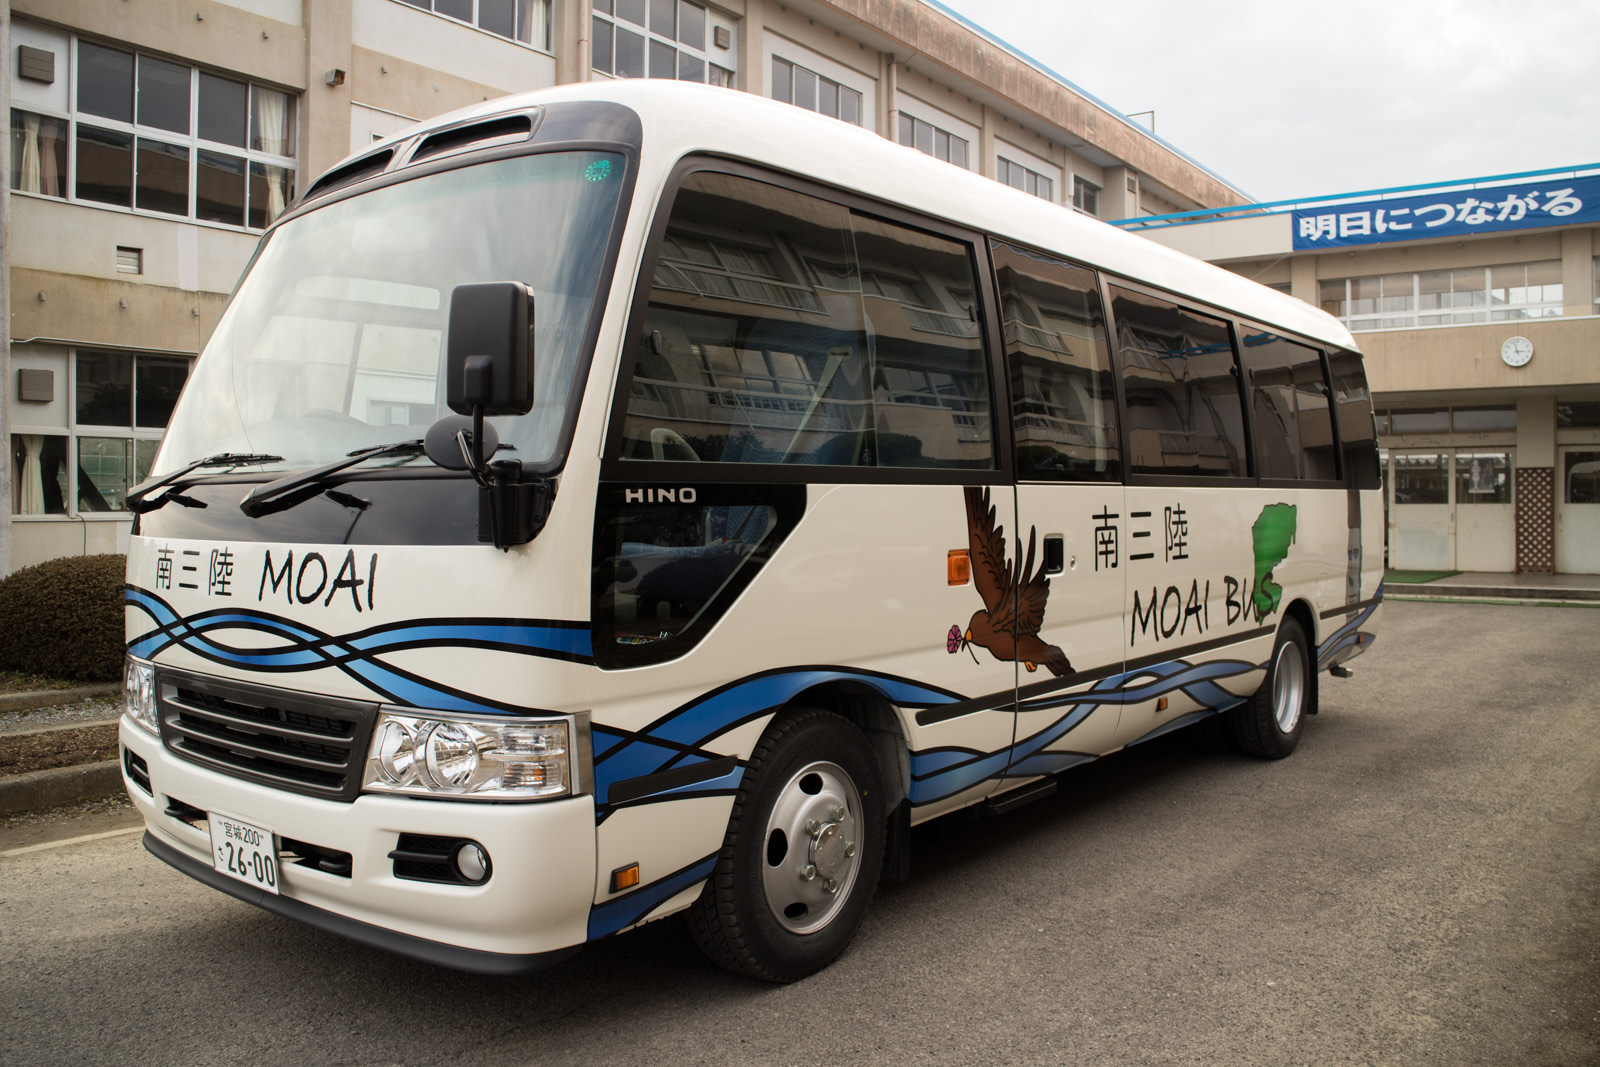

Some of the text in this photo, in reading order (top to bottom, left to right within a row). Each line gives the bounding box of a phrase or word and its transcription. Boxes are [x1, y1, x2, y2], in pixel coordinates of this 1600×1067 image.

[1299, 187, 1583, 242] 明日につながる
[625, 487, 697, 504] HINO
[1091, 502, 1189, 572] 南三陸
[155, 543, 379, 613] 南三陸 MOAI
[1130, 572, 1274, 647] MOAI BUS
